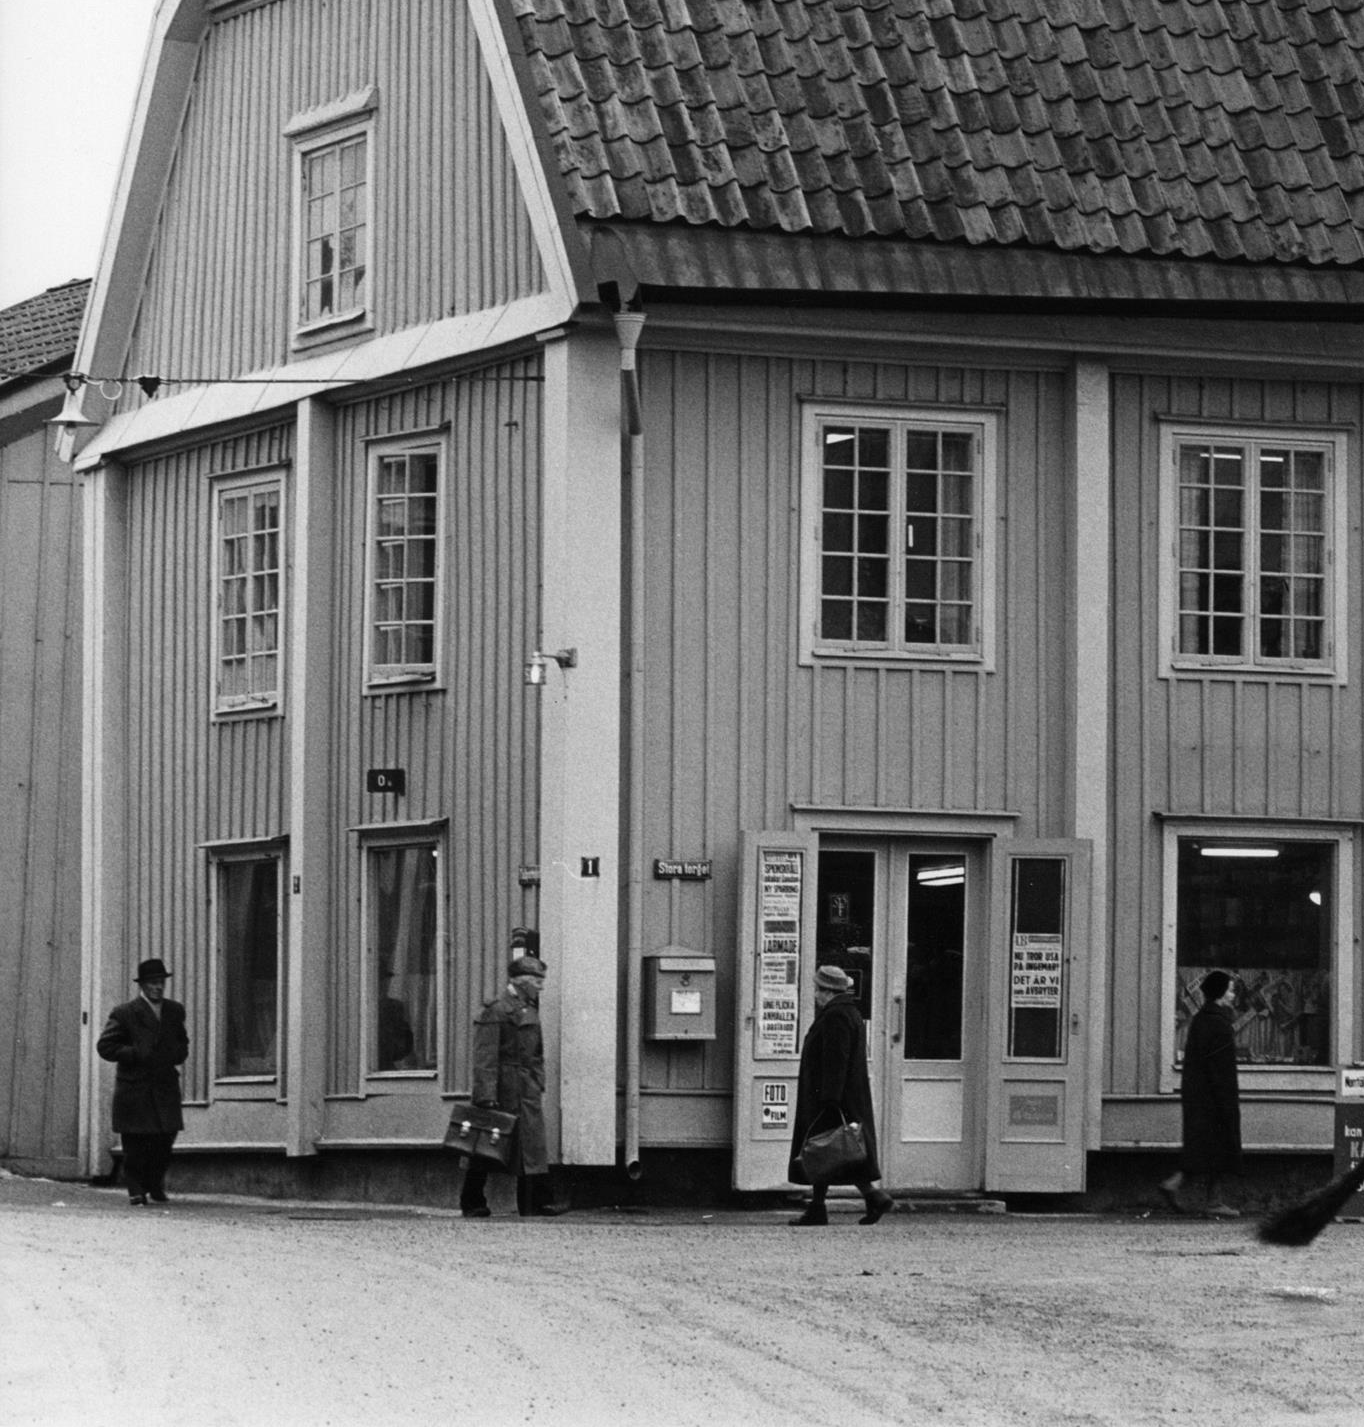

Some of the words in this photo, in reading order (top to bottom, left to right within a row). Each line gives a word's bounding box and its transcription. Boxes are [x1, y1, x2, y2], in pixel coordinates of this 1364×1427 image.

[587, 859, 594, 875] 1
[658, 862, 683, 874] Stora
[1014, 952, 1024, 961] NU
[1026, 952, 1043, 961] TROR
[1044, 952, 1059, 962] USA
[1013, 975, 1031, 985] DET
[1049, 976, 1059, 985] VI
[764, 1084, 786, 1102] FOTO
[1344, 1124, 1363, 1138] kan
